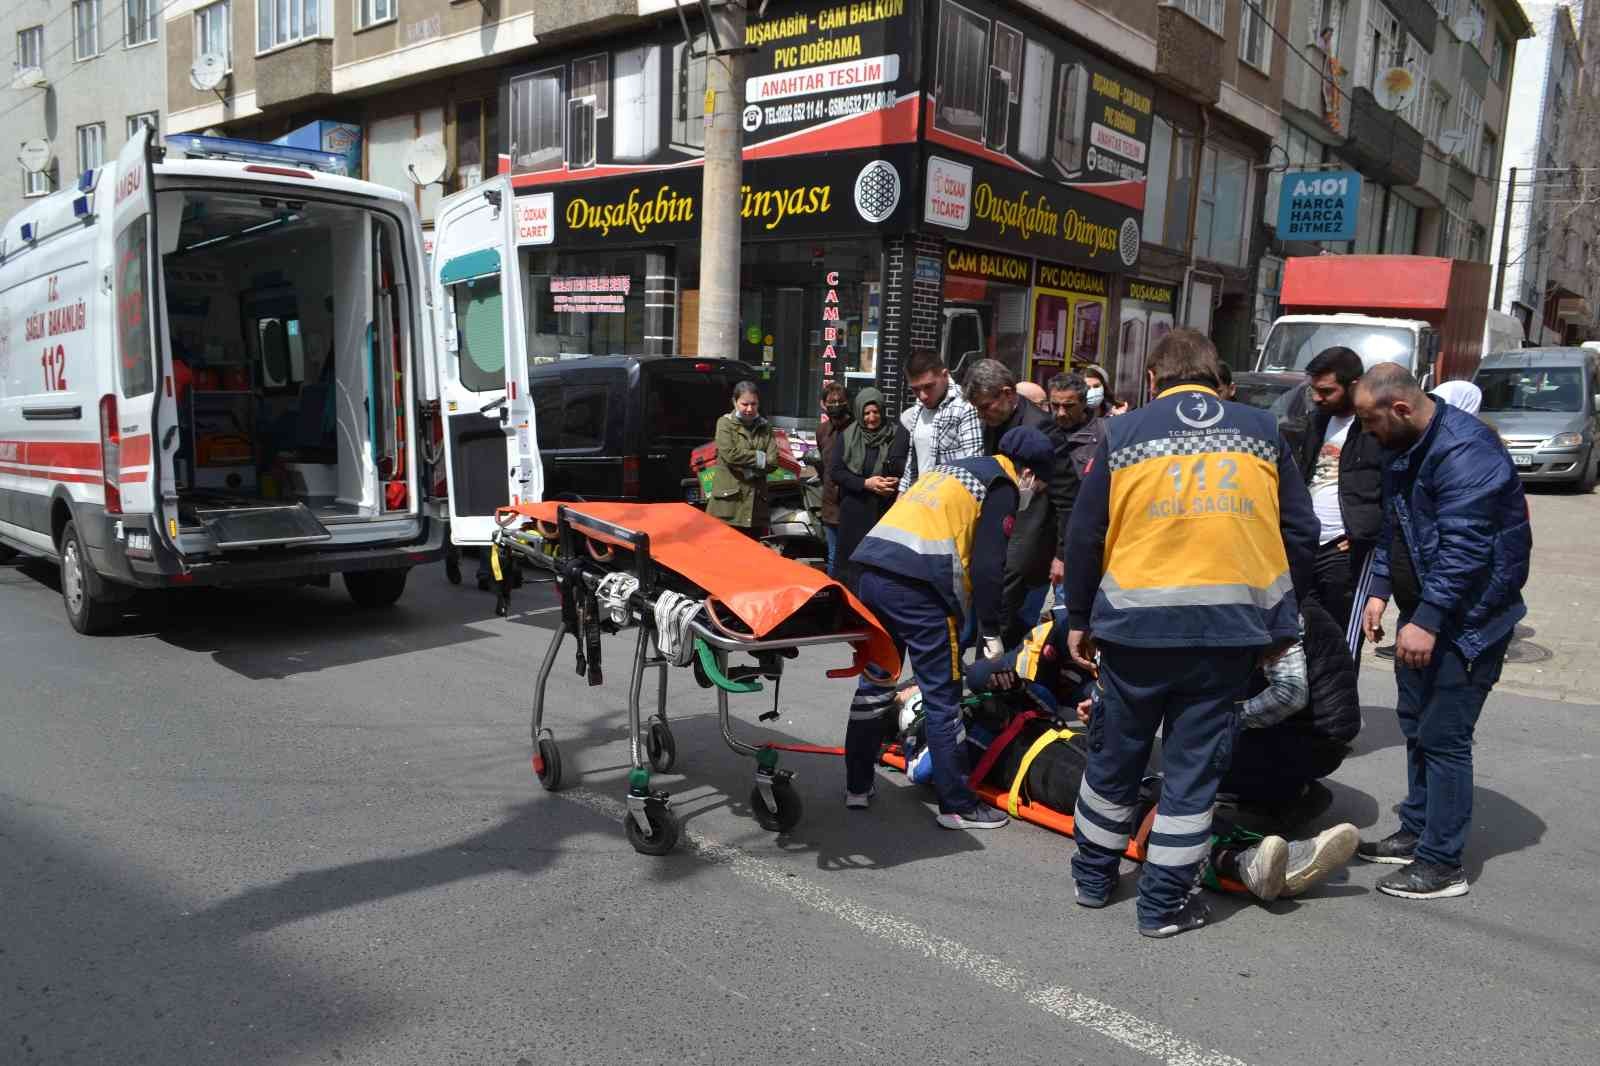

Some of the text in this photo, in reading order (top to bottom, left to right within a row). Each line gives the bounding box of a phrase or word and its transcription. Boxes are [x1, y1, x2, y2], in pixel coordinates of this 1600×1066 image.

[818, 9, 847, 31] CAM
[850, 0, 903, 25] BALKON
[774, 35, 861, 70] PVC DOĞRAMA
[761, 63, 881, 97] ANAHTAR TESLİM
[566, 186, 831, 236] Duşakabin ünyası
[974, 183, 1118, 257] Duşakabin Dünyası
[1290, 210, 1344, 222] HARCA
[1291, 198, 1344, 210] HARCA
[520, 225, 548, 238] CARET
[947, 249, 977, 272] CAM
[980, 254, 1028, 281] BALKON
[1040, 266, 1059, 286] PVC
[42, 344, 67, 391] 112
[1167, 458, 1239, 492] 112
